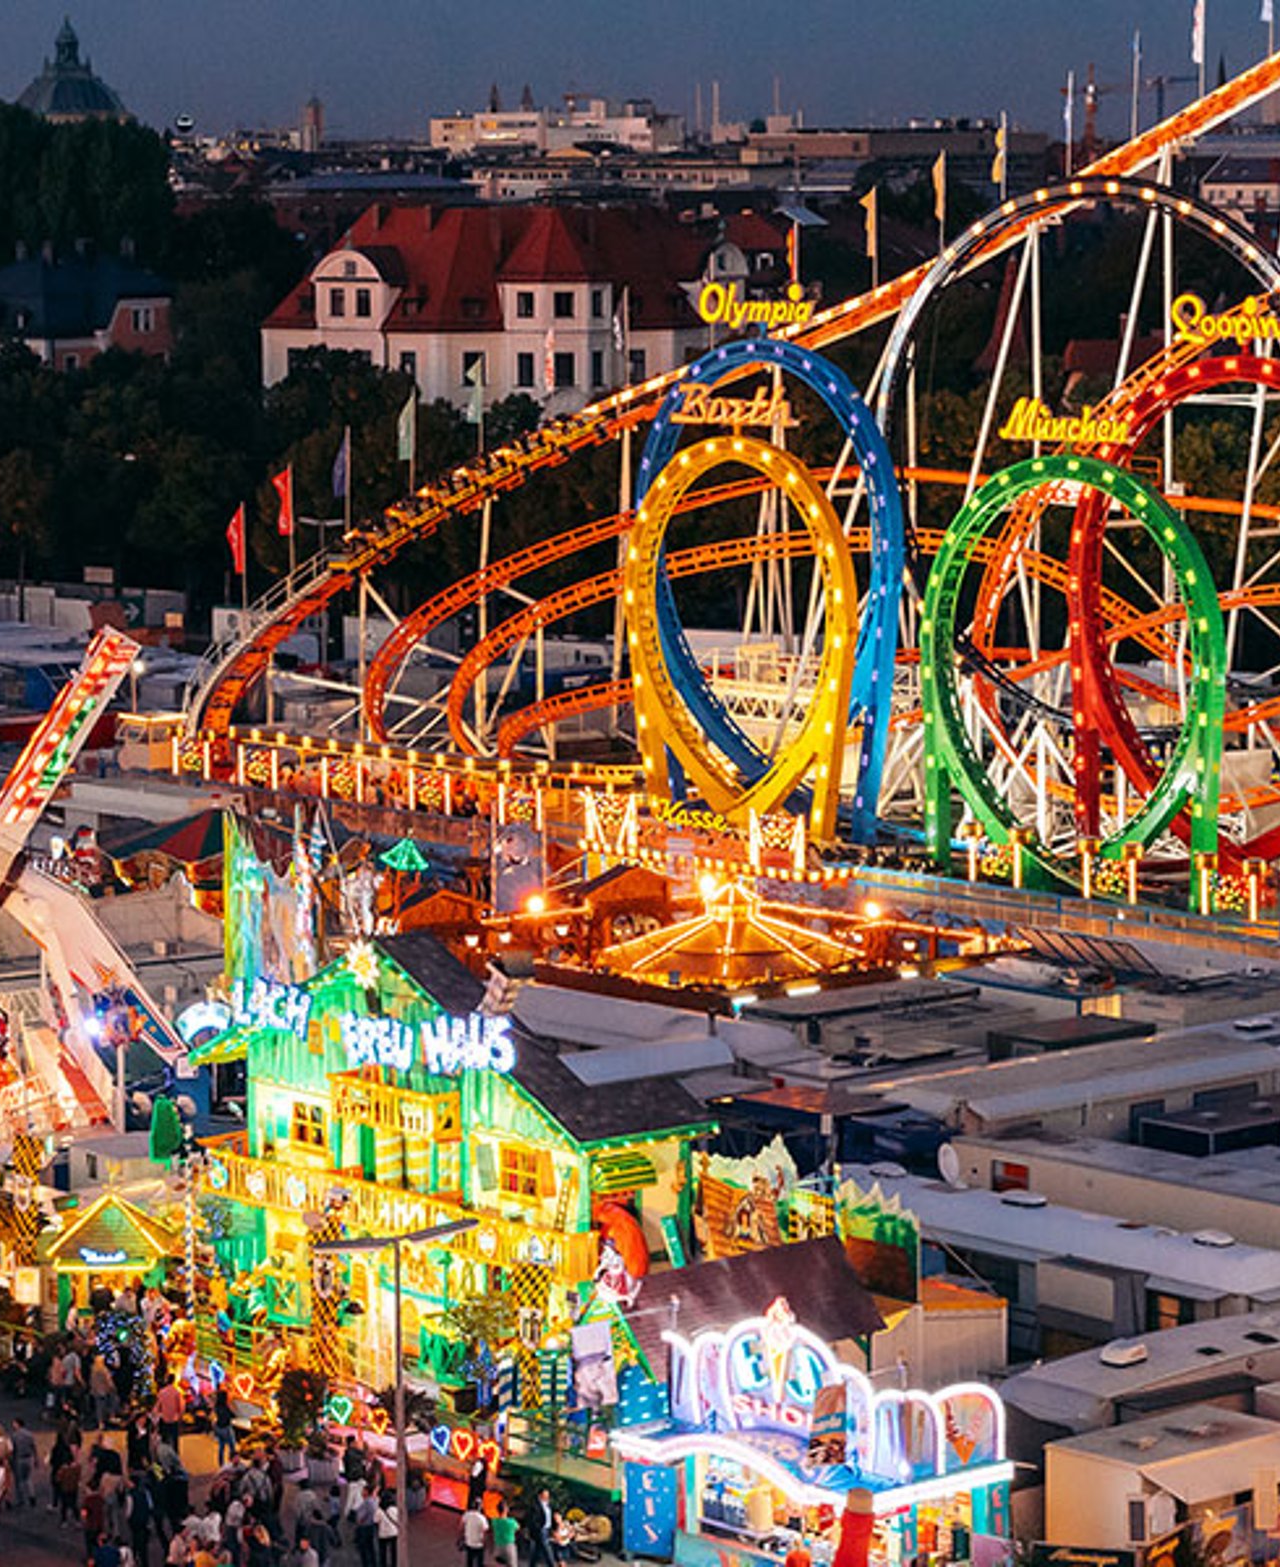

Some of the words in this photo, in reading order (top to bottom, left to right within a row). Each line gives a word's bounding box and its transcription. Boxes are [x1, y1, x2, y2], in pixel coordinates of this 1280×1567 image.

[699, 282, 812, 329] Olympia
[670, 383, 799, 426] Barth
[998, 397, 1131, 443] München
[657, 799, 727, 833] Kasse
[231, 976, 313, 1042] LACH
[421, 1011, 517, 1075] HAUS
[733, 1394, 815, 1428] SHO
